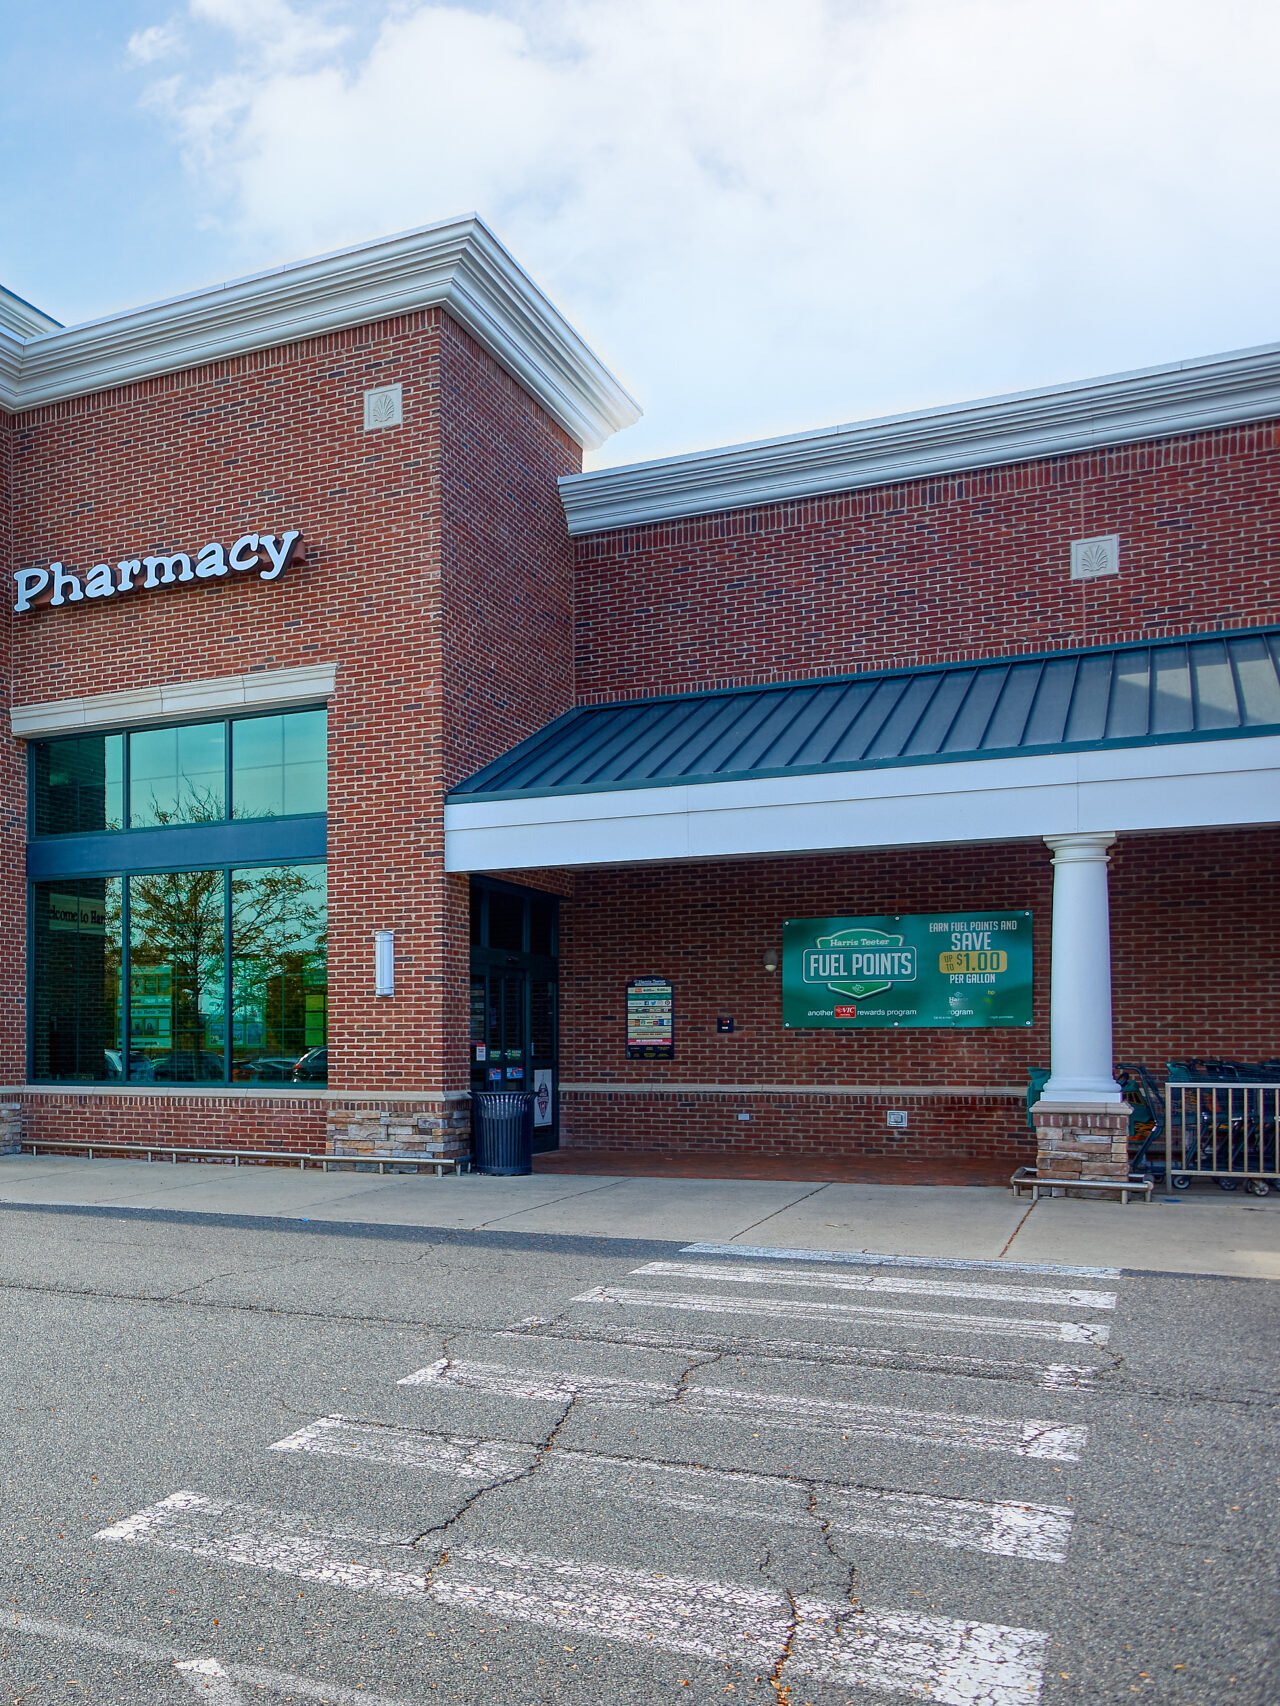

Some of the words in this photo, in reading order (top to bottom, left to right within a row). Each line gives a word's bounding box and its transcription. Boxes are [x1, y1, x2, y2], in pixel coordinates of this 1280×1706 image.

[13, 530, 300, 613] Pharmacy
[48, 904, 78, 922] elcome
[929, 922, 949, 933] EARN
[950, 921, 969, 932] FUEL
[970, 920, 999, 931] POINTS
[1000, 920, 1018, 931] AND
[830, 939, 859, 947] Harris
[860, 938, 890, 946] Teeter
[951, 932, 992, 951] SAVE
[810, 954, 848, 977] FUEL
[852, 952, 912, 976] POINTS
[944, 954, 953, 963] UP
[956, 952, 1000, 971] $1.00
[945, 963, 955, 972] TO
[949, 973, 964, 984] PER
[966, 973, 996, 984] GALLON
[807, 1009, 834, 1017] another
[857, 1008, 886, 1016] rewards
[886, 1009, 917, 1017] program
[949, 1009, 974, 1017] ogram
